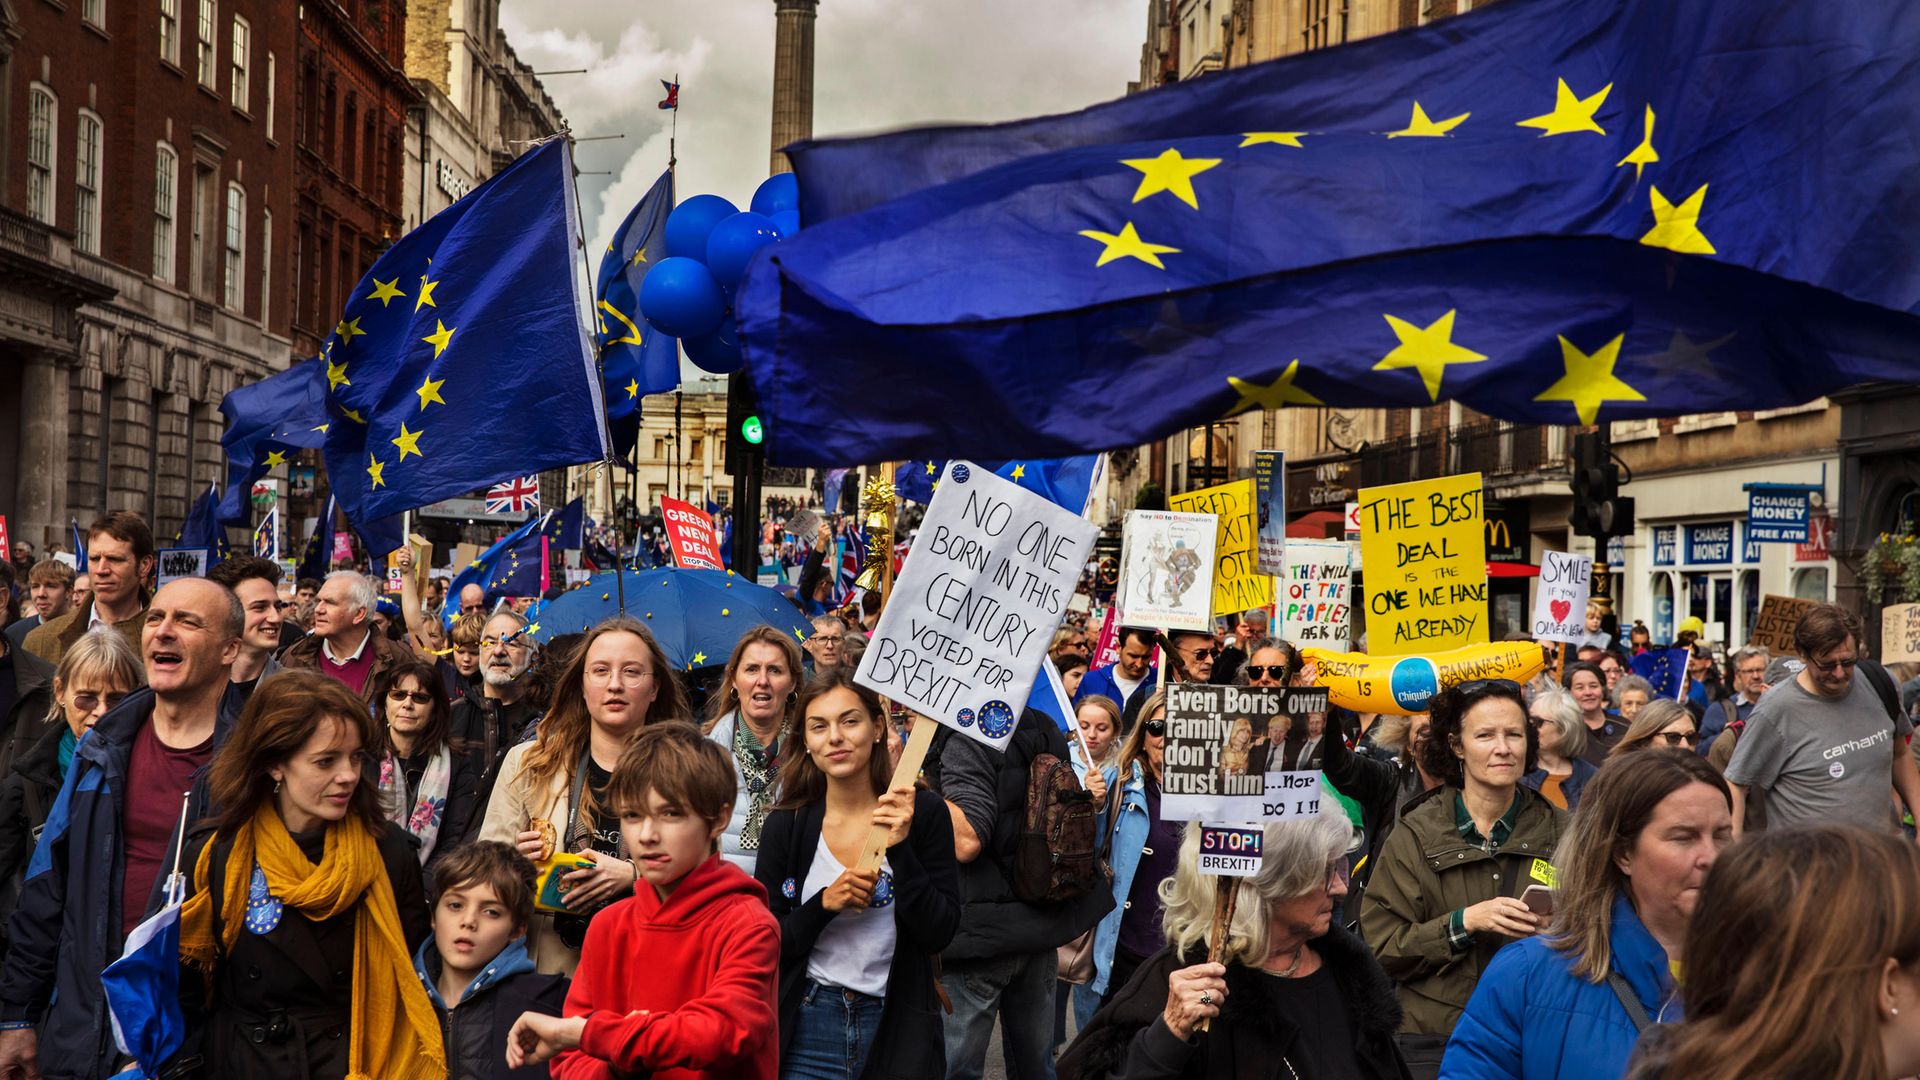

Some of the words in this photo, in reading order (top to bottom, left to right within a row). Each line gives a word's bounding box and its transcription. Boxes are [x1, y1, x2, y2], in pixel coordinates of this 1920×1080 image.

[1172, 492, 1237, 517] TIRED
[1363, 498, 1419, 533] THE
[1428, 489, 1481, 527] BEST
[1752, 496, 1805, 507] CHANGE
[666, 509, 712, 532] GREEN
[1752, 507, 1805, 519] MONEY
[678, 525, 709, 544] NEW
[962, 490, 1012, 536] NO
[1017, 521, 1075, 574] ONE
[1694, 528, 1729, 541] CHANGE
[1751, 529, 1779, 539] FREE
[1782, 530, 1805, 540] ATM
[681, 541, 716, 561] DEAL
[683, 557, 701, 565] STOP
[1397, 538, 1458, 568] DEAL
[1693, 543, 1729, 560] MONEY
[929, 526, 991, 573] BORN
[992, 558, 1019, 590] IN
[1019, 572, 1060, 614] THIS
[1290, 564, 1317, 580] THE
[1320, 565, 1349, 580] WILL
[1405, 572, 1418, 583] IS
[1432, 567, 1459, 580] THE
[1543, 552, 1588, 584] SMILE
[1290, 583, 1311, 599] OF
[1318, 583, 1345, 598] THE
[1372, 589, 1410, 615] ONE
[1419, 586, 1444, 608] WE
[1451, 583, 1487, 605] HAVE
[1548, 587, 1556, 598] IF
[1560, 586, 1577, 599] YOU
[926, 573, 1036, 657] CENTURY
[1286, 602, 1350, 623] PEOPLE?
[1301, 626, 1329, 640] ASK
[1335, 625, 1348, 640] US
[1395, 613, 1477, 644] ALREADY
[1756, 616, 1797, 634] LISTE
[1755, 633, 1774, 647] TO
[911, 619, 973, 666] VOTED
[973, 658, 1013, 692] FOR
[867, 638, 972, 713] BREXIT
[1316, 661, 1369, 677] BREXIT
[1357, 681, 1371, 696] IS
[1398, 688, 1432, 703] Chiquita
[1166, 685, 1217, 713] Even
[1224, 687, 1284, 715] Boris'
[1288, 693, 1327, 713] own
[1166, 712, 1234, 746] family
[1165, 740, 1220, 767] don't
[1823, 728, 1888, 760] carhartt
[1164, 768, 1217, 794] trust
[1224, 769, 1263, 795] him
[1263, 803, 1285, 816] DO
[1296, 802, 1304, 815] I
[1204, 831, 1260, 853] STOP!
[1202, 856, 1255, 871] BREXIT!
